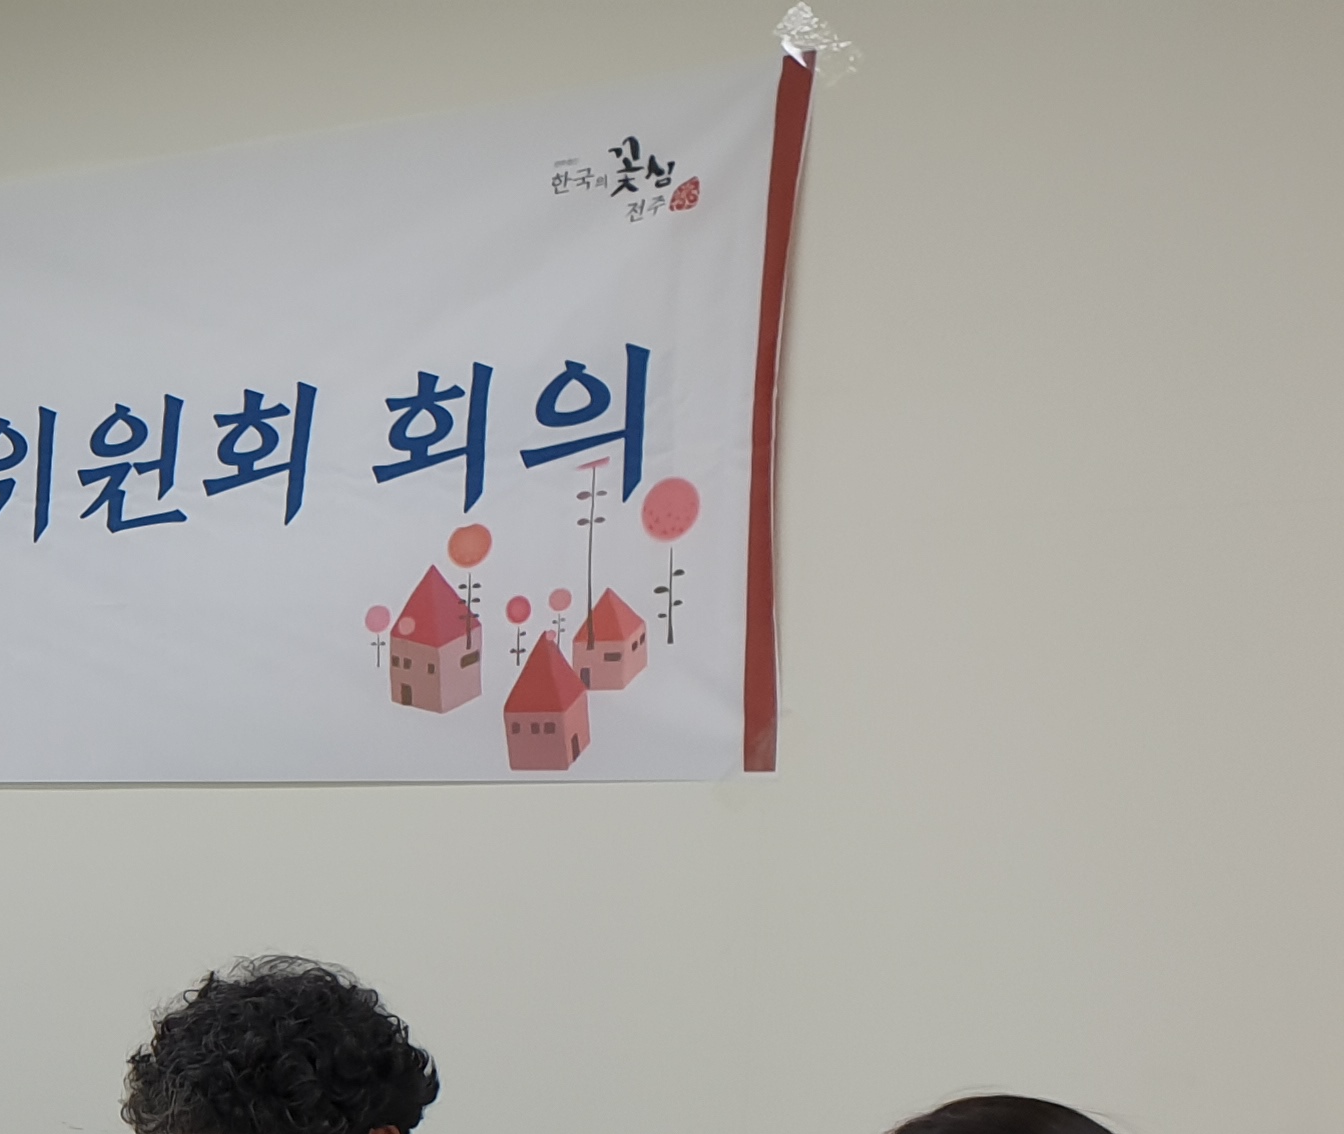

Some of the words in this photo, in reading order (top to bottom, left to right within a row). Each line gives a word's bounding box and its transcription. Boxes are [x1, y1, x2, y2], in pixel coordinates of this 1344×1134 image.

[551, 167, 608, 195] 한국의
[608, 136, 676, 197] 꽃심
[626, 195, 666, 223] 전주
[371, 342, 652, 513] 회의
